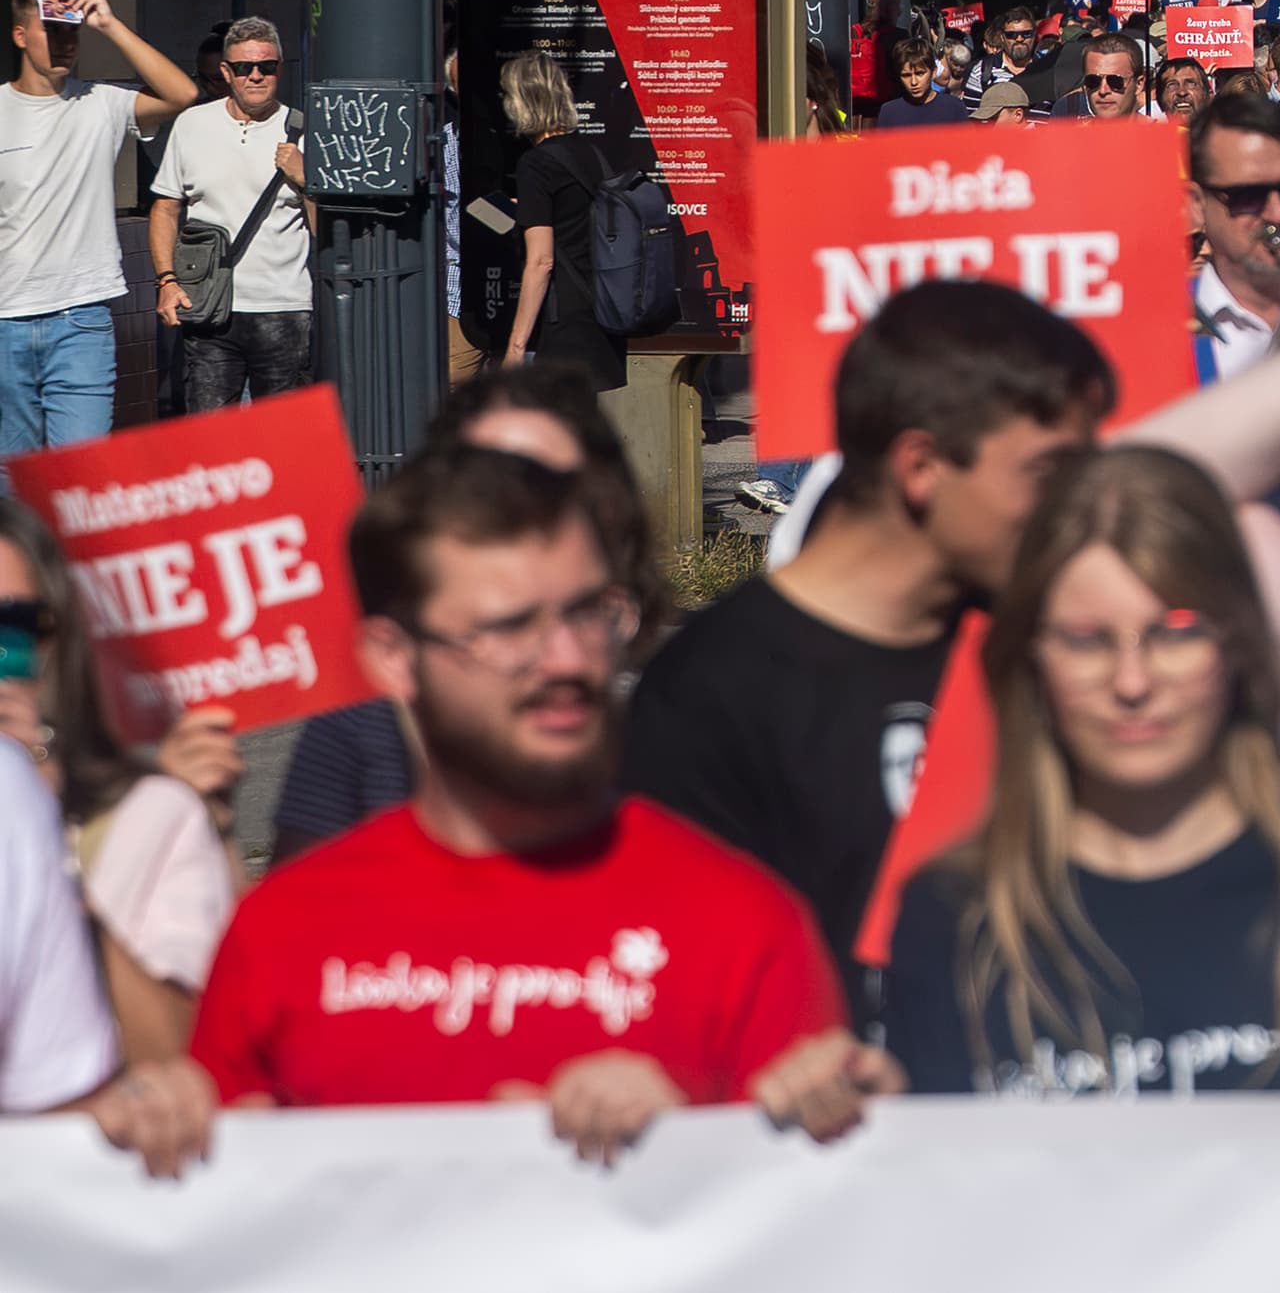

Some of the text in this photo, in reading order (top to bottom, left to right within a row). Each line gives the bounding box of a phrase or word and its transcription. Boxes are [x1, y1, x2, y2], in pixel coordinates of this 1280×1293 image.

[1175, 31, 1244, 45] CHRÁNIŤ.
[1186, 17, 1231, 29] Ženy treba
[1187, 48, 1233, 61] Od počatia.
[890, 156, 1033, 217] Dieťa
[52, 457, 273, 538] Materstvo
[69, 515, 325, 640] NIE JE
